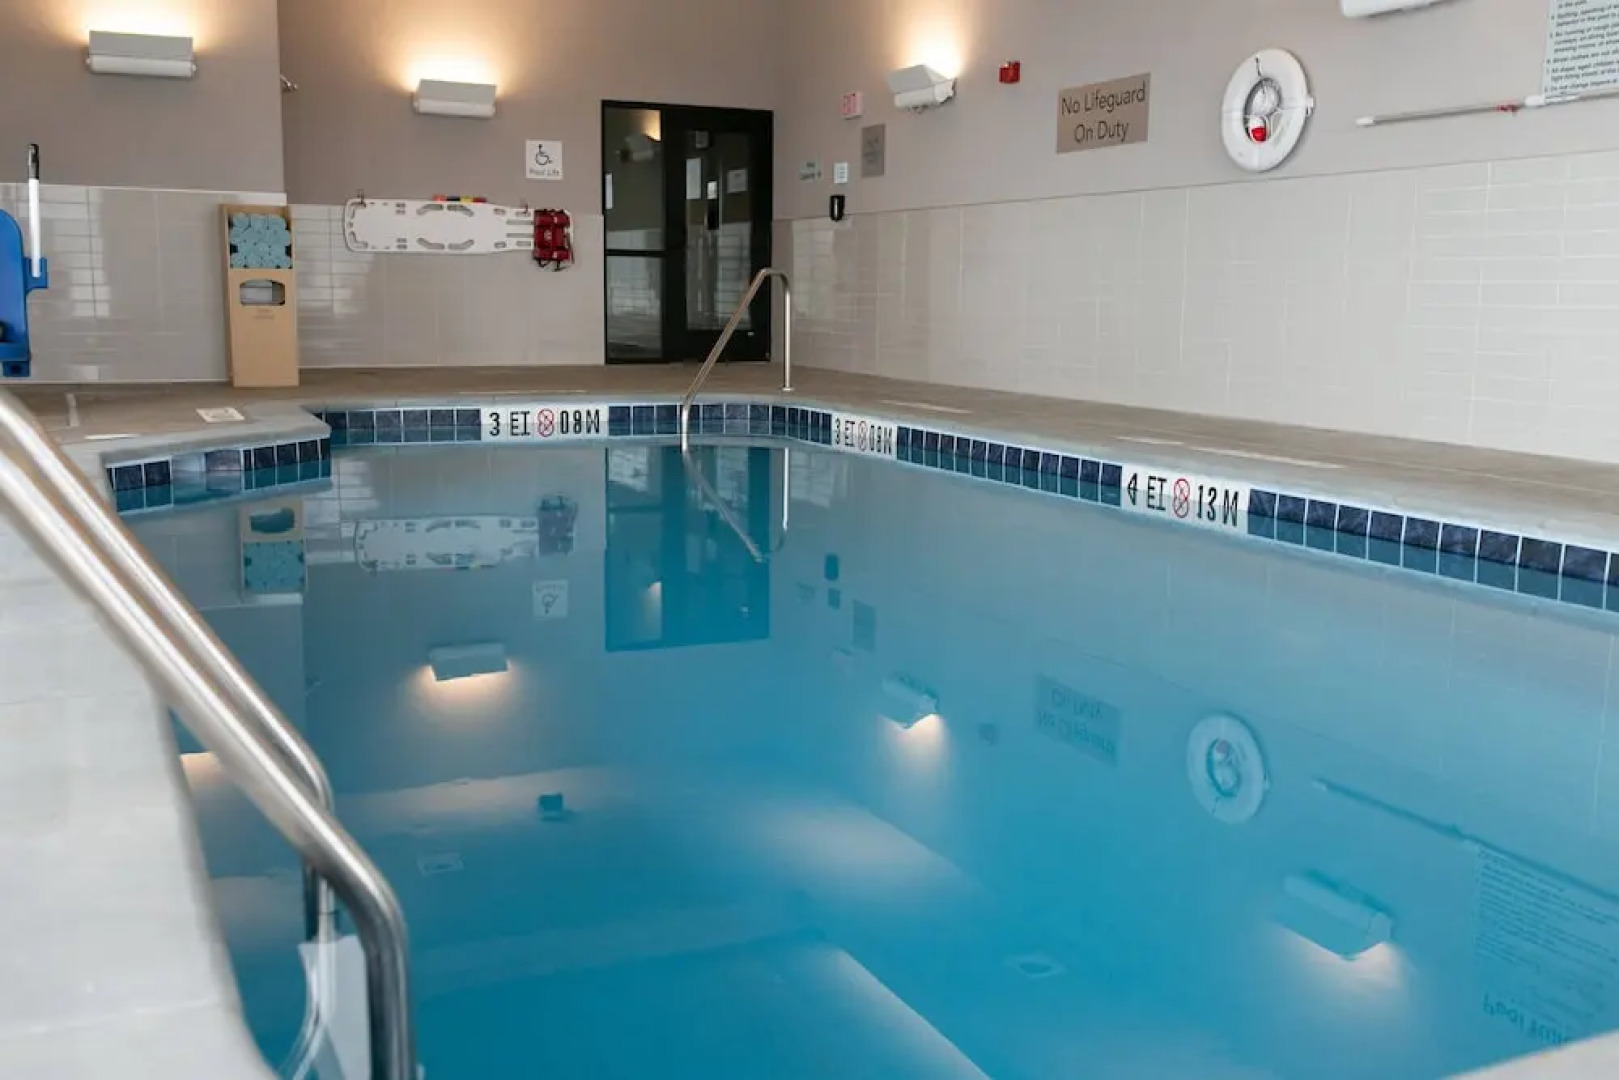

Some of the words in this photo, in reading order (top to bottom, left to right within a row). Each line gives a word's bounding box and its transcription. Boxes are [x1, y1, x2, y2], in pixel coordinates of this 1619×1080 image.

[1061, 96, 1080, 116] No
[1084, 79, 1146, 113] Lifeguard
[1074, 123, 1094, 144] On
[1097, 119, 1130, 143] Duty
[489, 411, 501, 437] 3
